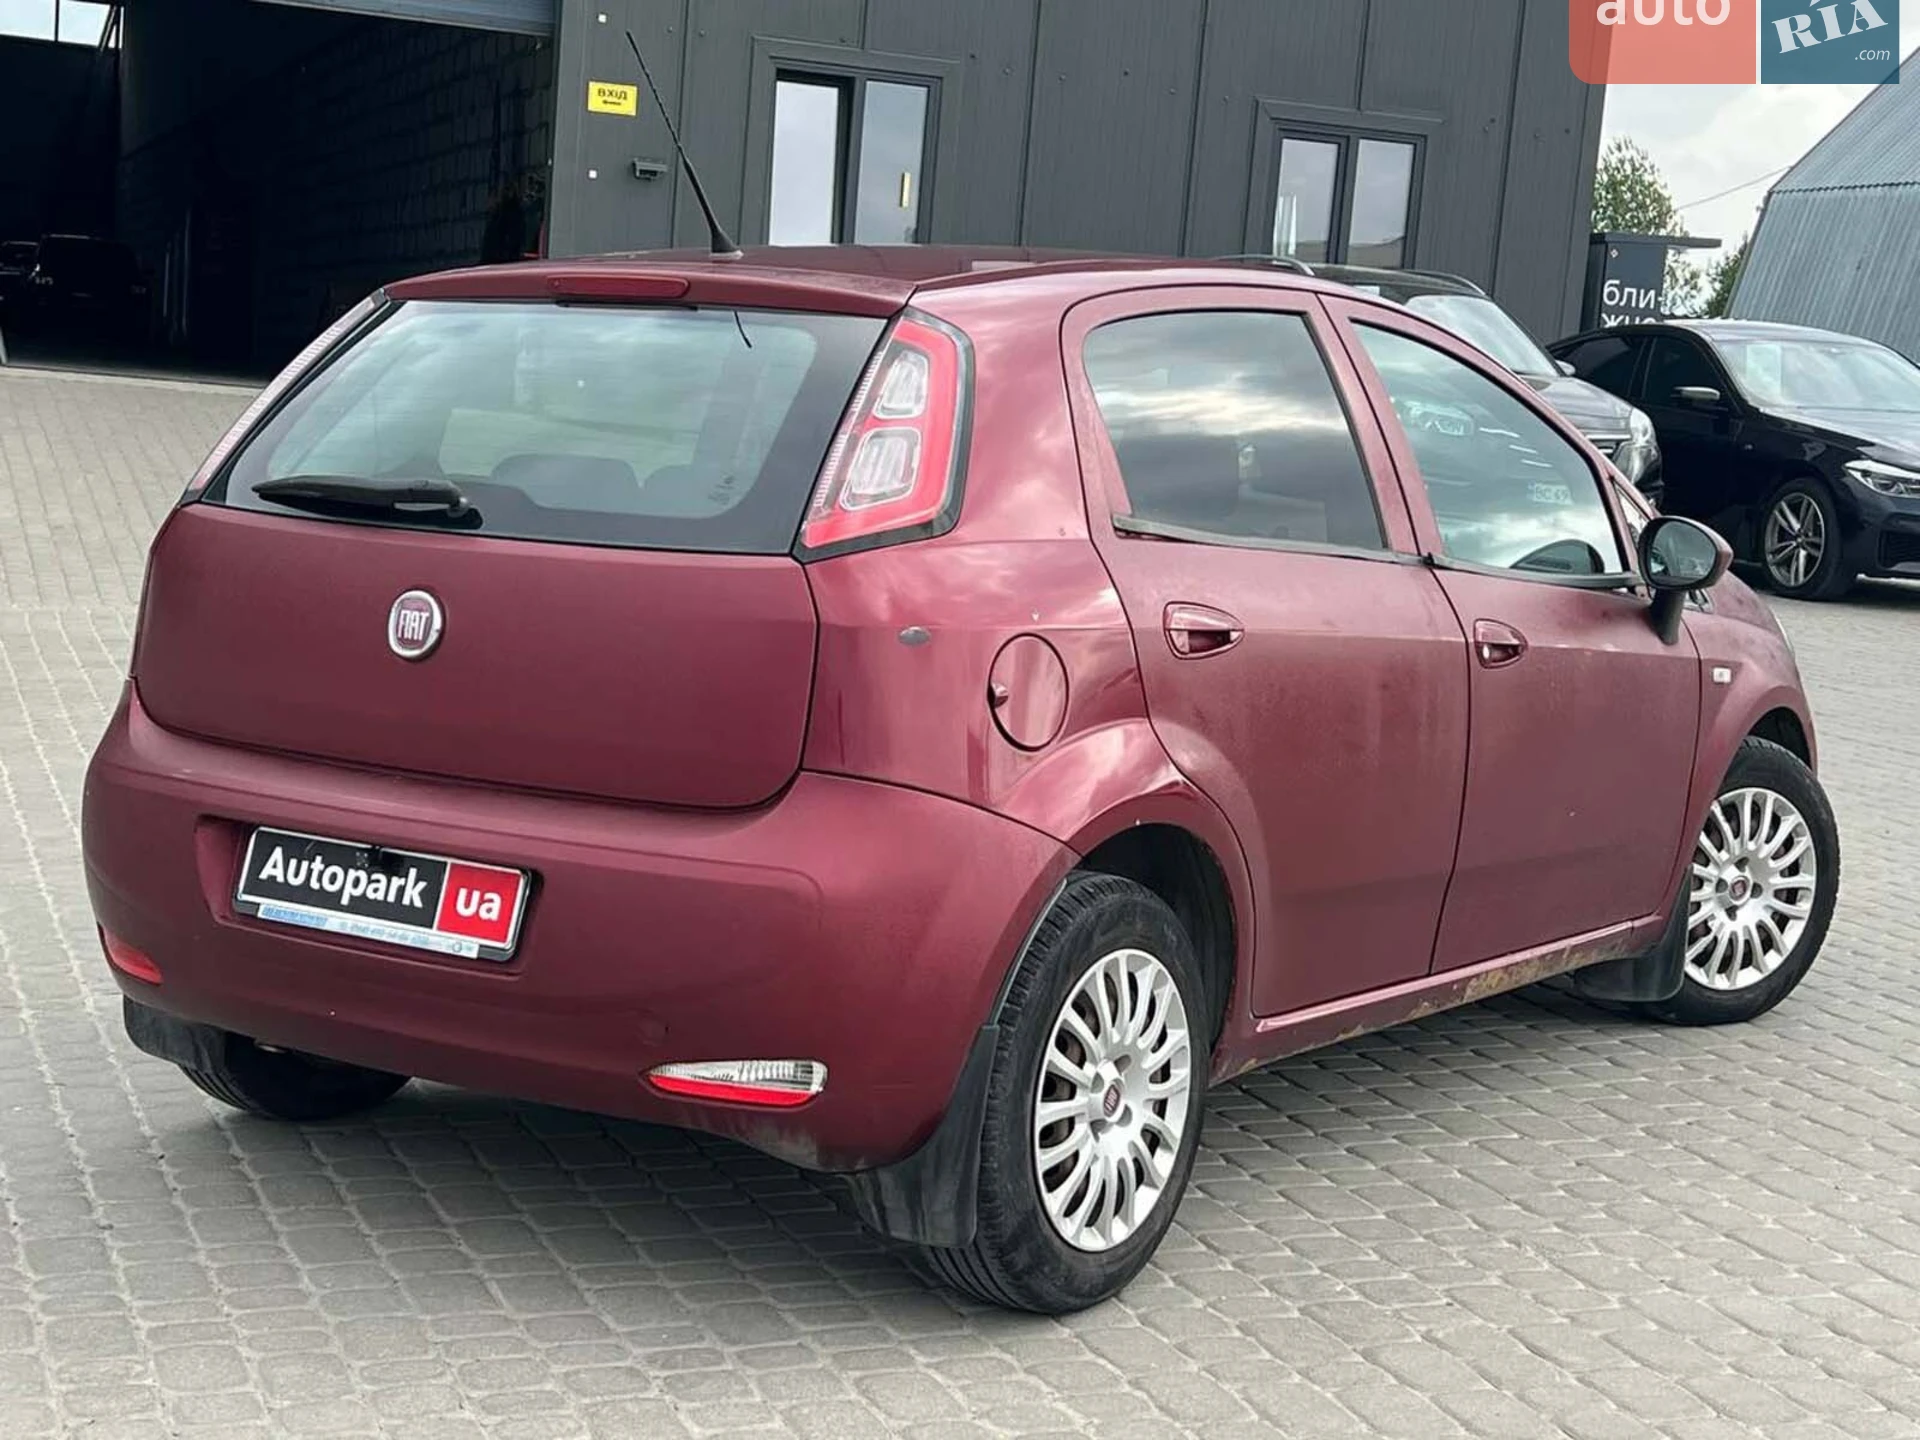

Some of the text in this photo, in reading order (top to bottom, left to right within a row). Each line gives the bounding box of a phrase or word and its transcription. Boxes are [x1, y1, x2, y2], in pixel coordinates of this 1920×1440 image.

[398, 610, 430, 641] FIAT
[258, 846, 502, 922] Autopark ua
